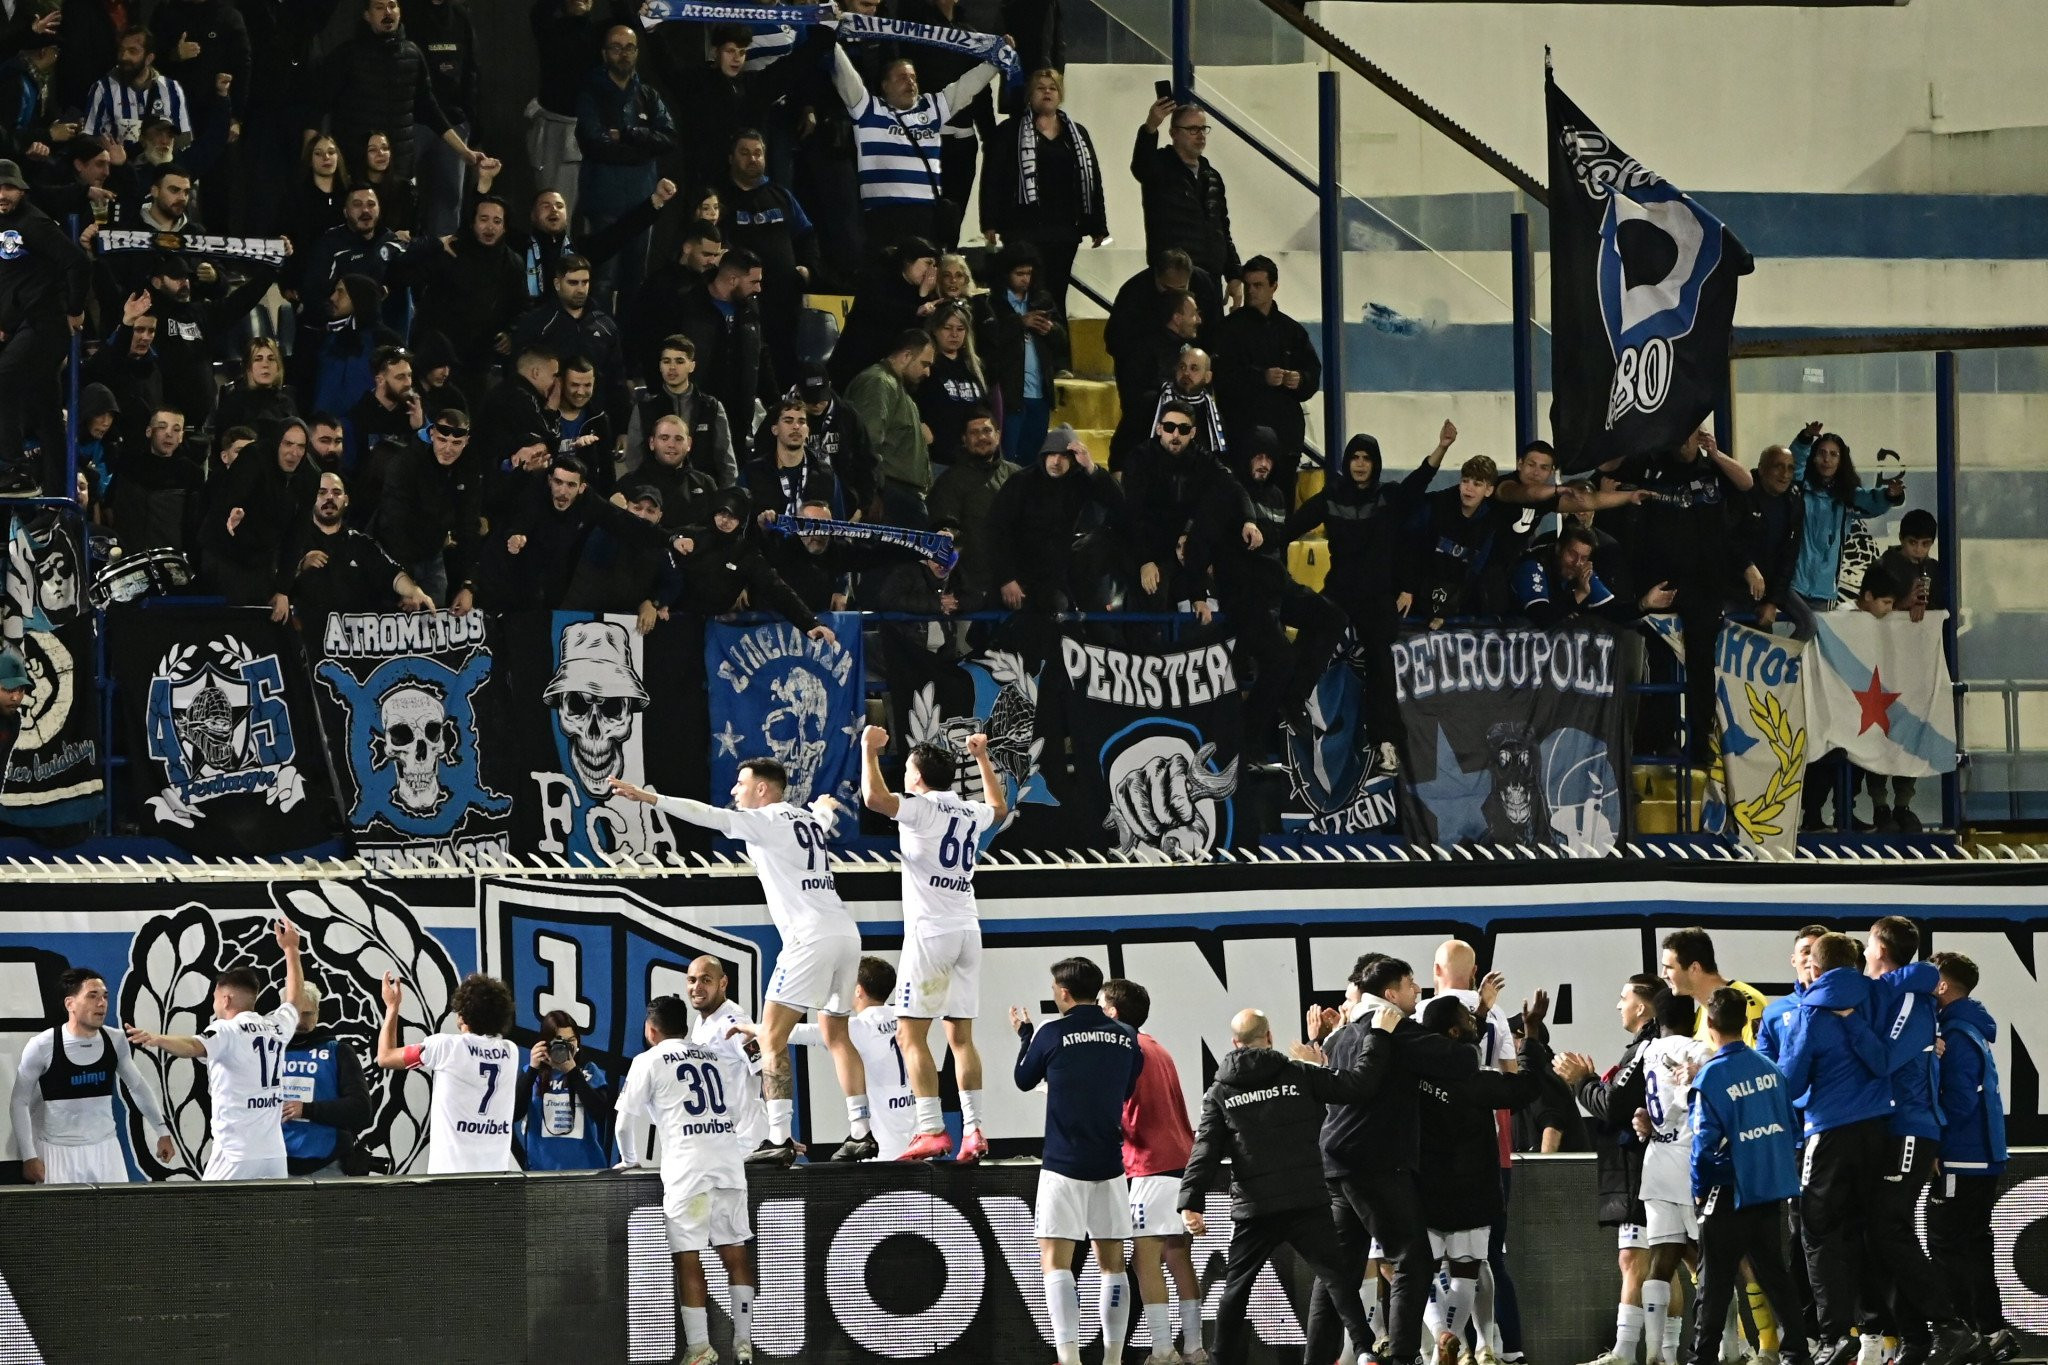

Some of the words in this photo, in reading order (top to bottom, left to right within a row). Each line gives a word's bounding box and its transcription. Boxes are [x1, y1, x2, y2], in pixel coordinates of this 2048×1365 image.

[888, 125, 935, 140] noibet
[324, 608, 486, 658] ATROMITOS
[1390, 629, 1615, 703] PETROUPOLI
[792, 820, 830, 872] 99
[938, 816, 977, 872] 66
[801, 875, 835, 891] novib
[1062, 1030, 1117, 1047] ATROMITOS
[1118, 1034, 1132, 1050] F.C.
[252, 1035, 283, 1088] 12
[308, 1048, 330, 1060] 16
[468, 1045, 510, 1060] WARDA
[662, 1049, 718, 1065] PALMEZANO
[478, 1061, 501, 1116] 7
[676, 1062, 727, 1116] 30
[1755, 1073, 1778, 1092] BOY
[1224, 1087, 1280, 1109] ATROMITOS
[1282, 1085, 1300, 1097] F.C.
[456, 1118, 510, 1135] novibet
[1739, 1123, 1785, 1142] NOVA
